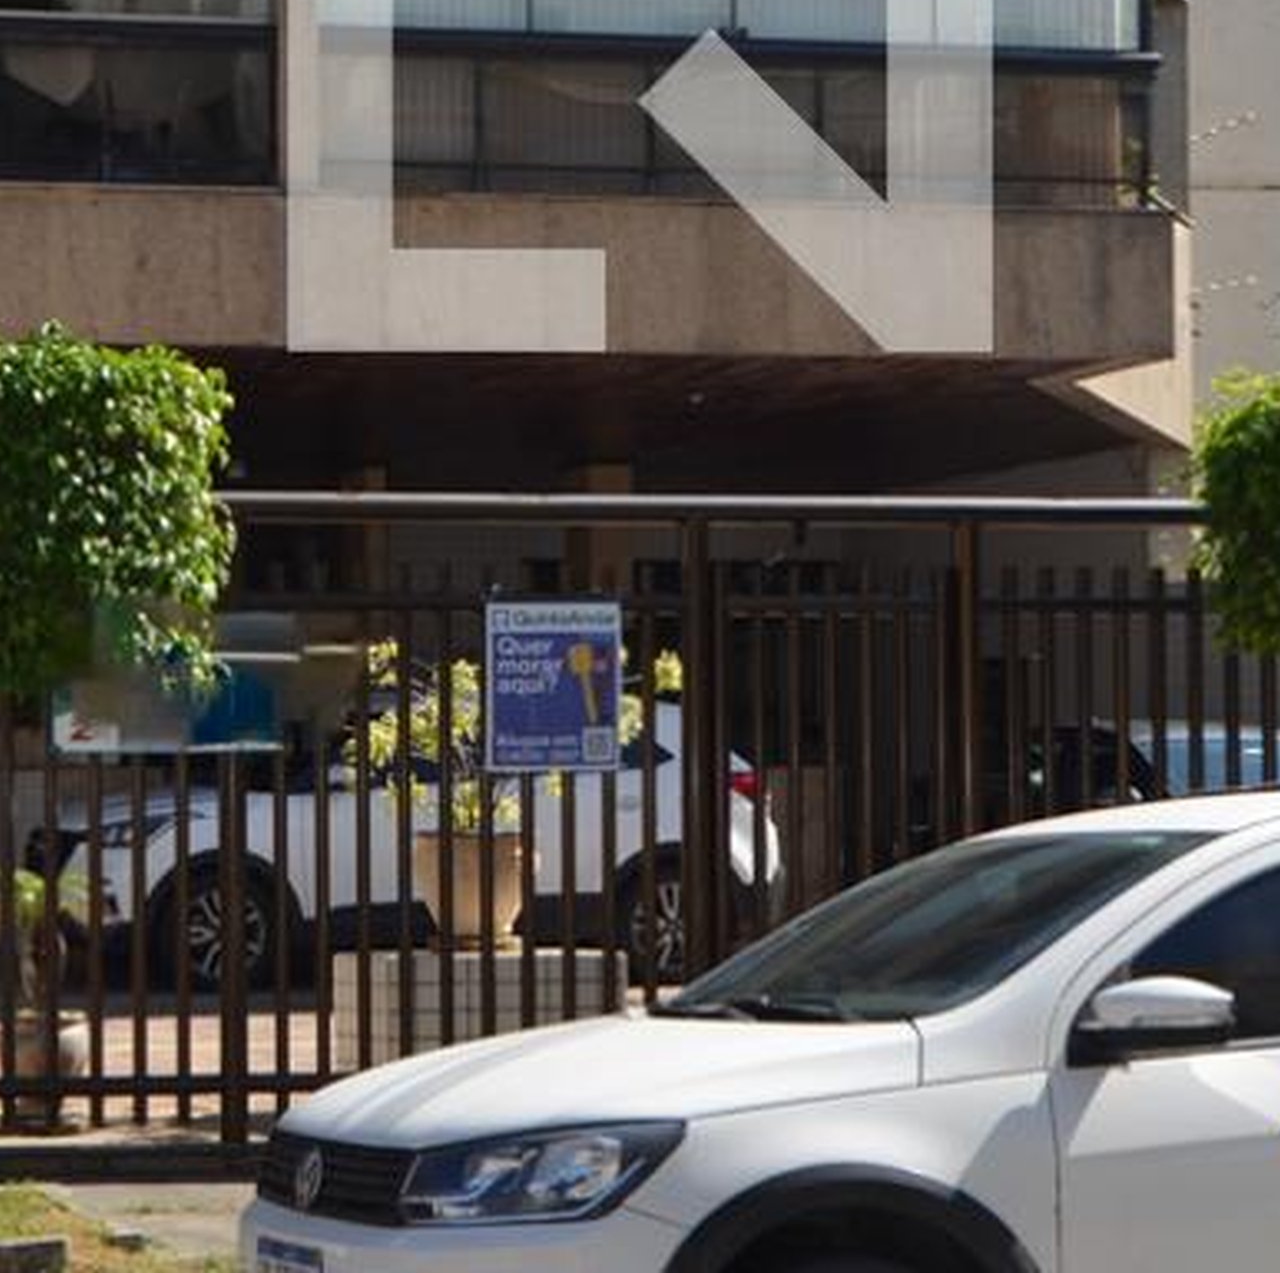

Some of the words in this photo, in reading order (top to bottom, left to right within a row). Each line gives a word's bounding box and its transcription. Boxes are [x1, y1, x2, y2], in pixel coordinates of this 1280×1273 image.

[497, 636, 554, 656] Quer
[497, 658, 563, 674] morar
[497, 675, 559, 695] aqui?
